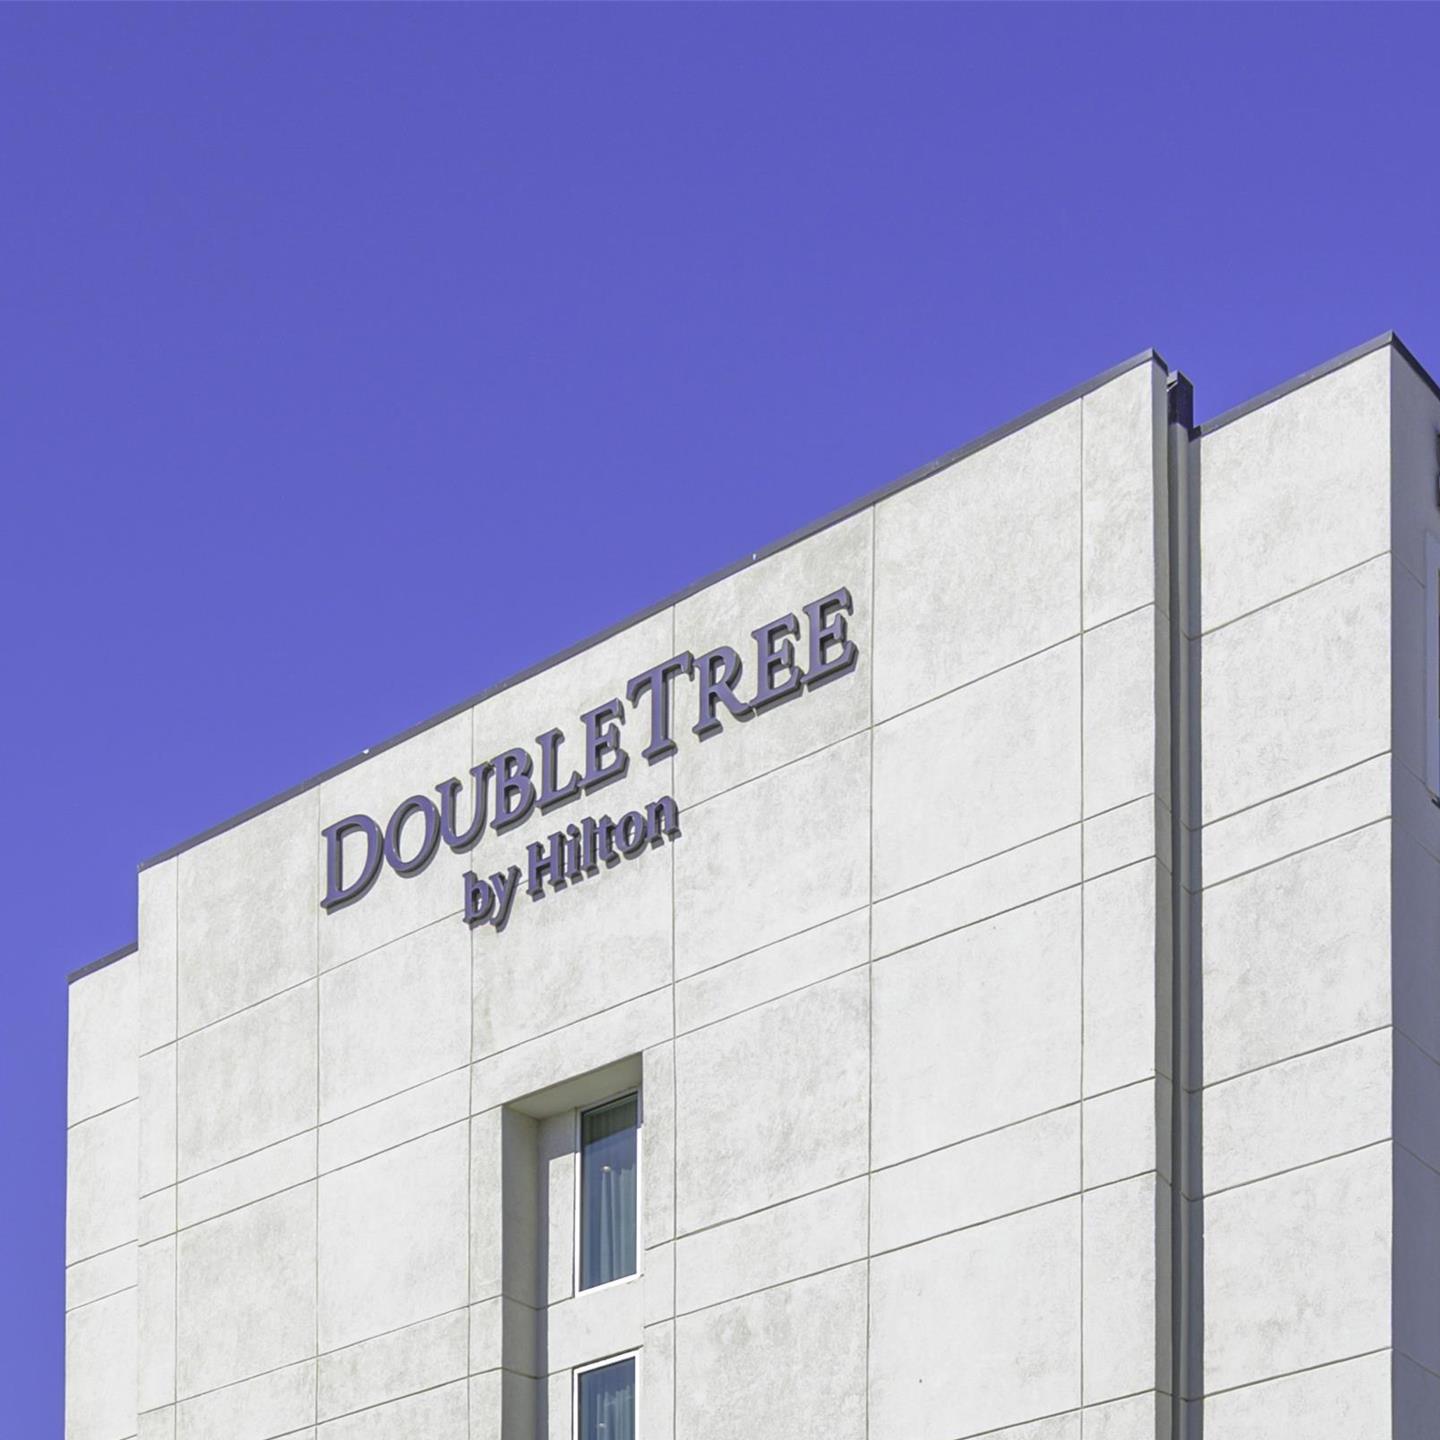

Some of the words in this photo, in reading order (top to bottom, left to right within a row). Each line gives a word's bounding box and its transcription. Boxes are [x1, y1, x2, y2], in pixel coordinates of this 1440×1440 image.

[321, 587, 859, 914] DOUBLETREE
[463, 865, 521, 931] by
[527, 796, 682, 901] Hilton
